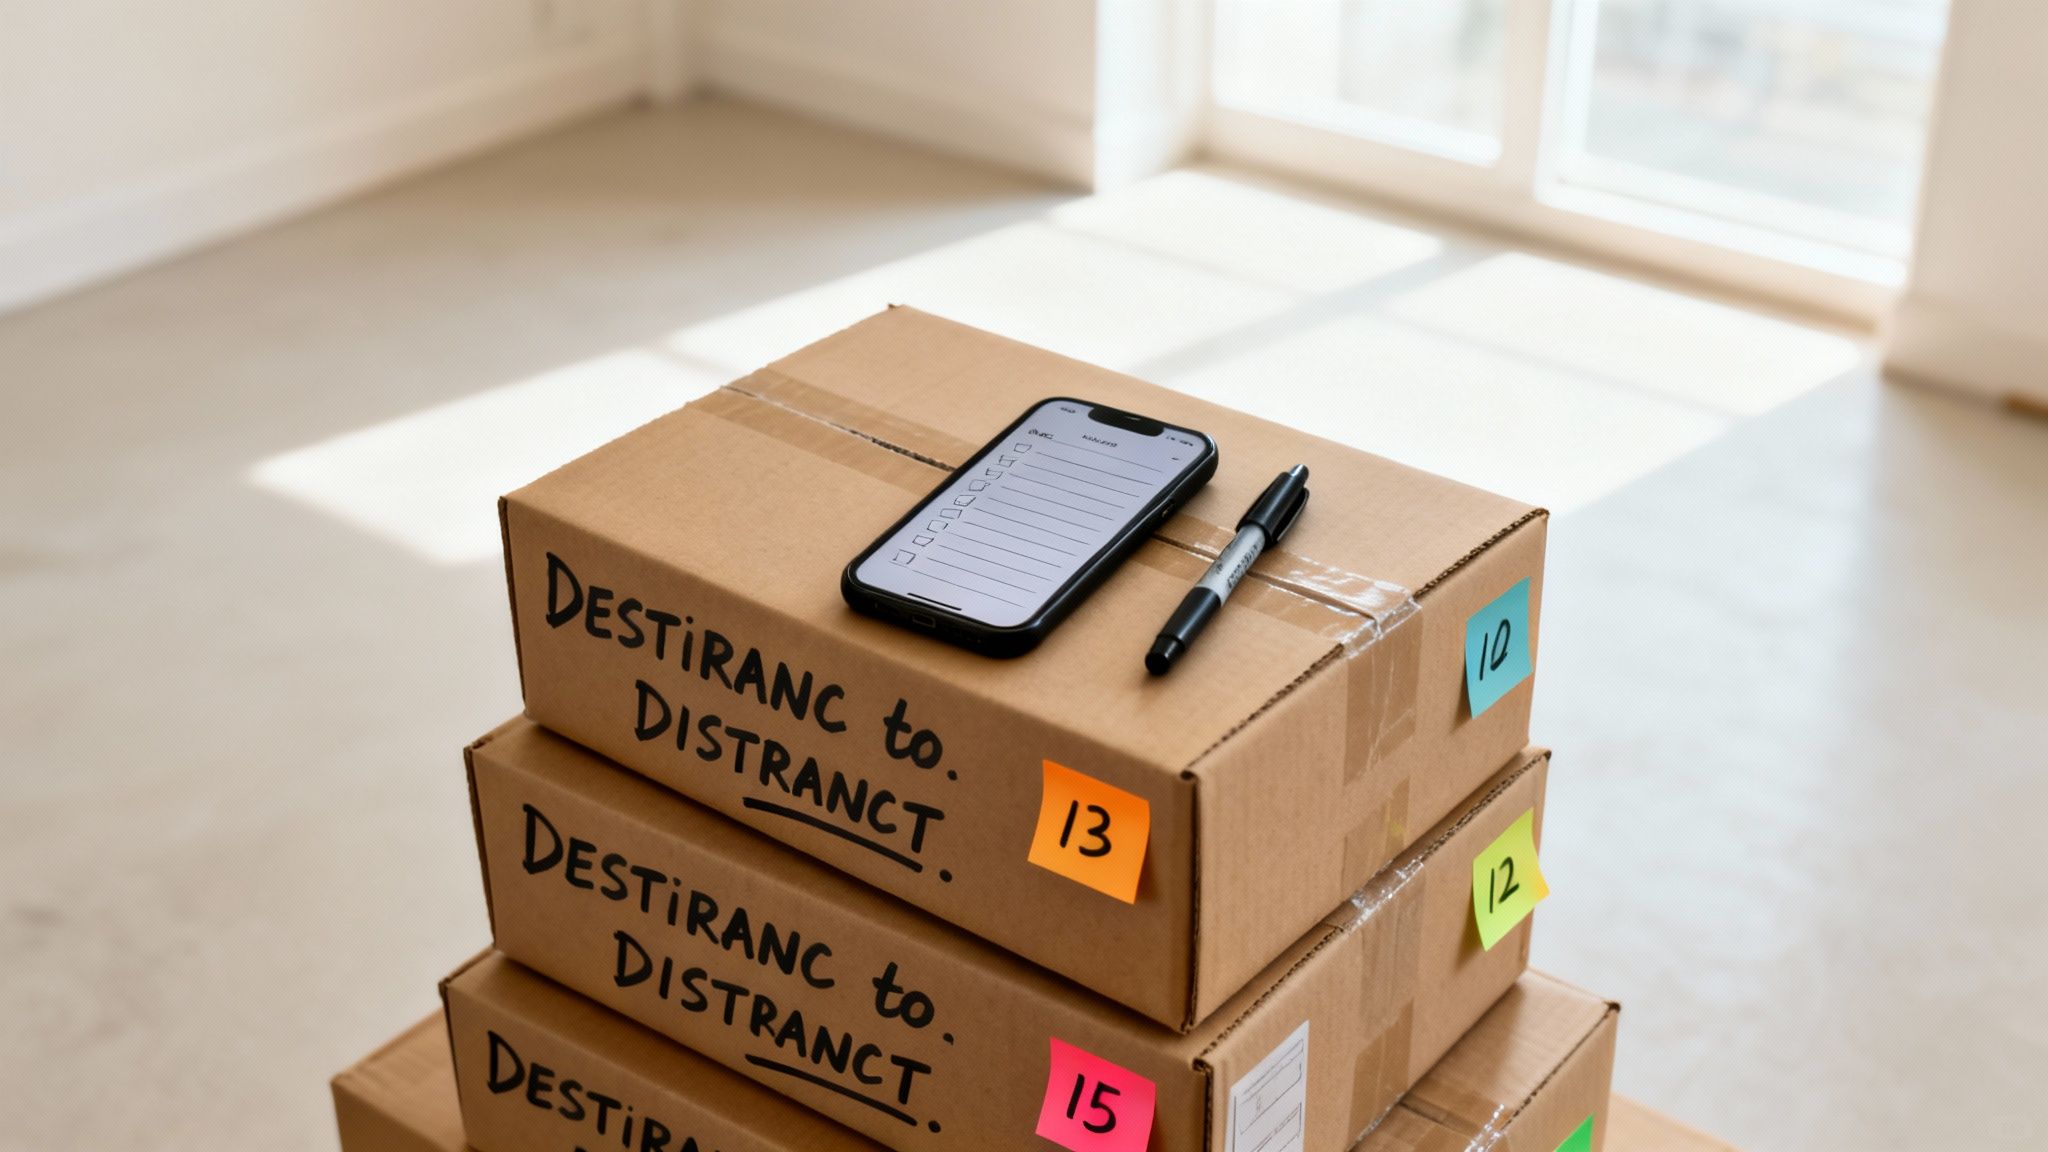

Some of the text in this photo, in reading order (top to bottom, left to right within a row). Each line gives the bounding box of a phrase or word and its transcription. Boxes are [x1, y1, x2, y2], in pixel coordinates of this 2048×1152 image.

[1479, 617, 1512, 682] 10
[883, 698, 958, 781] to.
[1060, 800, 1112, 858] 13
[1489, 856, 1520, 914] 12
[1066, 1073, 1121, 1134] 15
